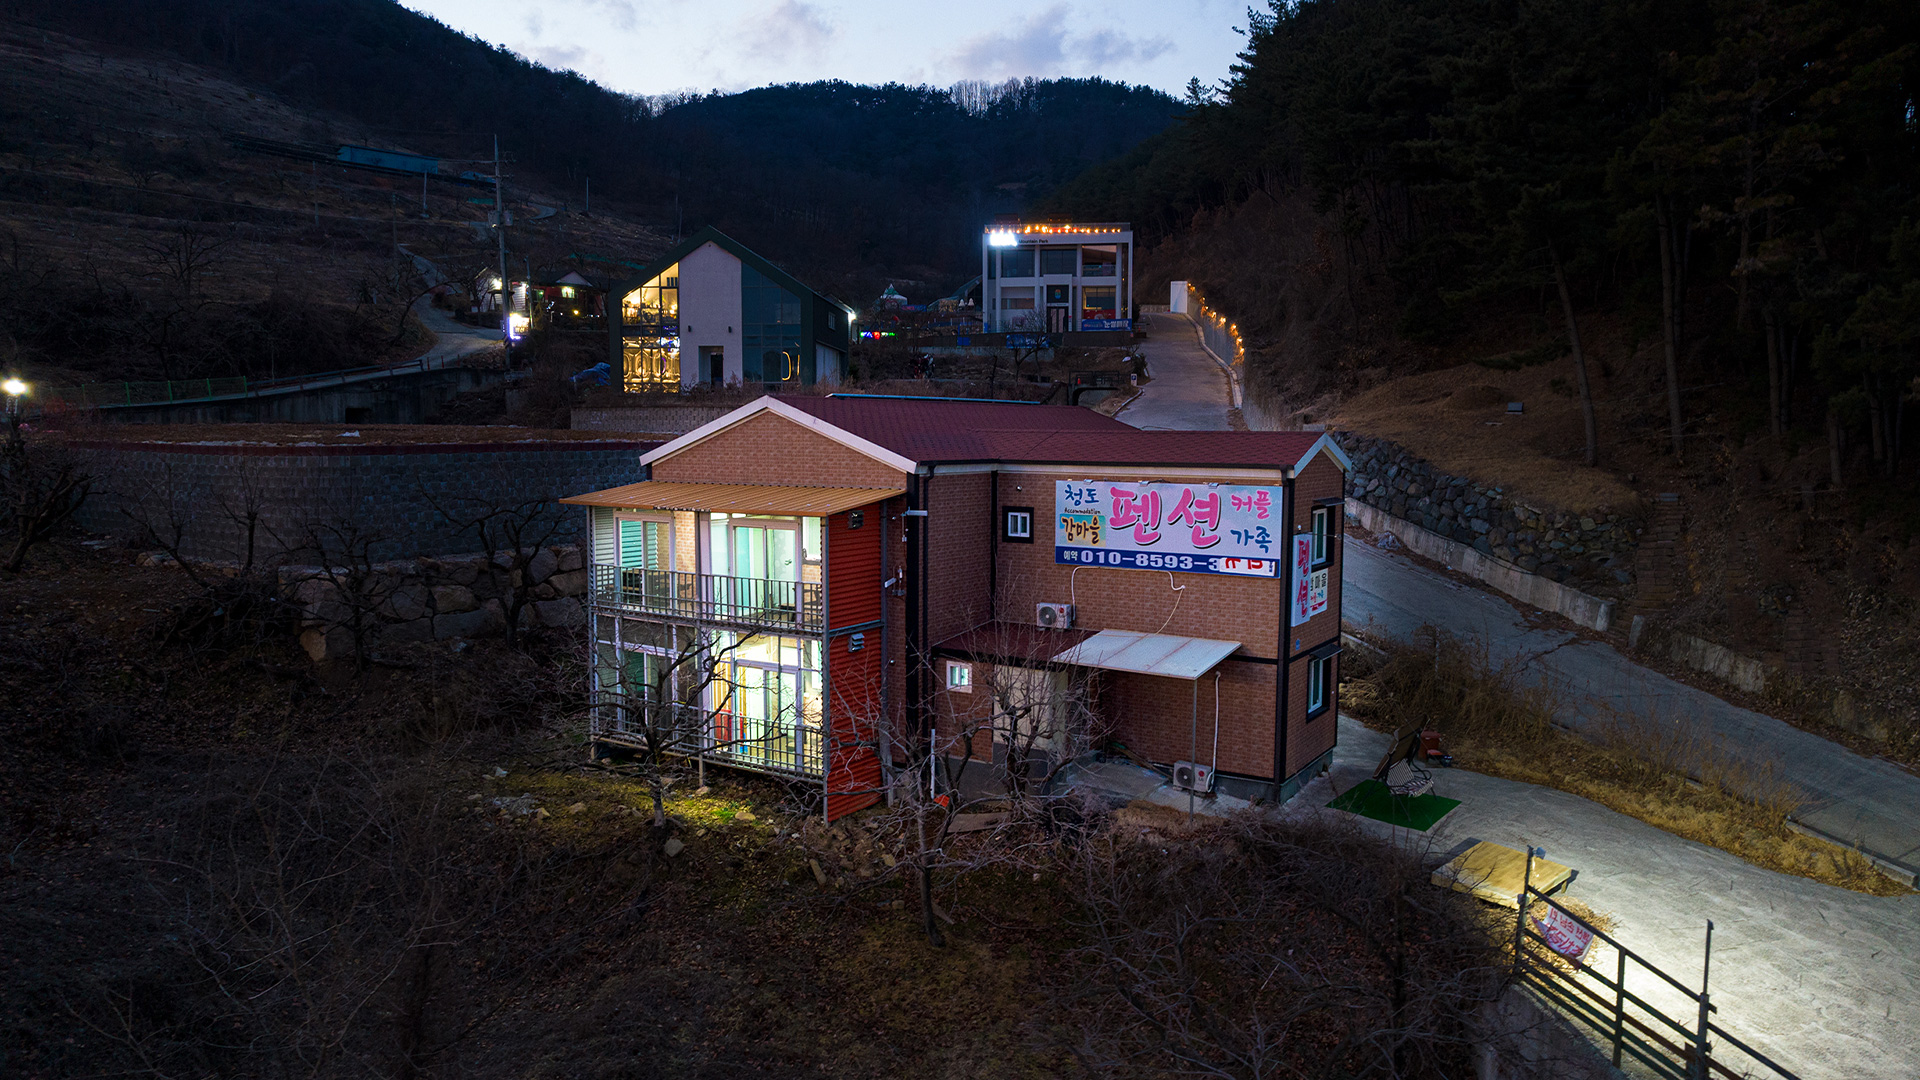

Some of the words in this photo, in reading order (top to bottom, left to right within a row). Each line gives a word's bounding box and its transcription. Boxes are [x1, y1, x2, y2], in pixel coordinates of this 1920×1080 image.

[1064, 484, 1099, 506] 청도
[1231, 490, 1272, 520] 커플
[1062, 516, 1100, 544] 감마을
[1109, 487, 1221, 548] 펜션
[1230, 525, 1272, 553] 가족
[1063, 550, 1078, 561] 예약
